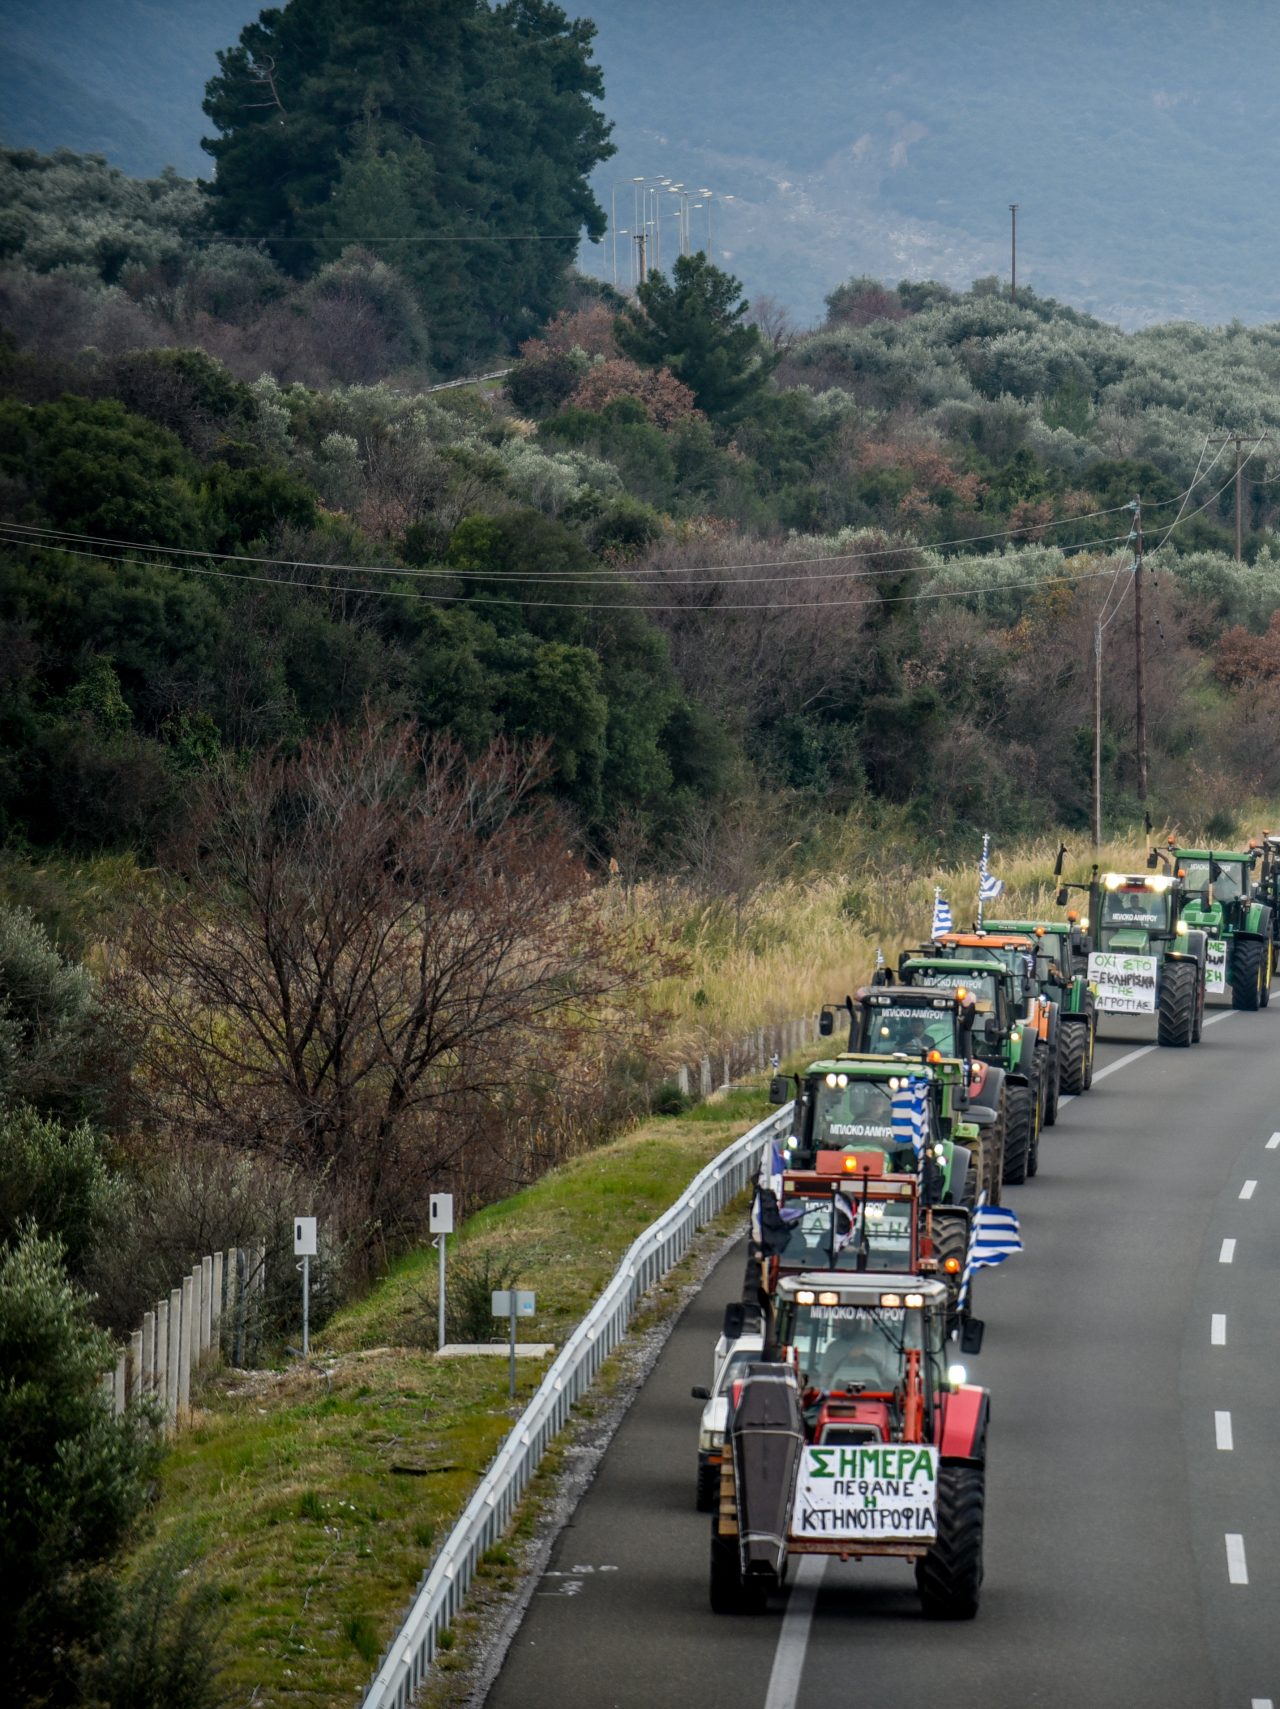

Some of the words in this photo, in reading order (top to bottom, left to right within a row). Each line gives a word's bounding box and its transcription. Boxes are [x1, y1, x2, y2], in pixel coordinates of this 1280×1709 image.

[1110, 985, 1134, 997] ΤΗΣ
[1096, 996, 1152, 1011] ΑΓΡΟΤΙΑΣ
[881, 1008, 911, 1018] ΜΠΛΟΚΟ
[830, 1123, 864, 1136] ΜΠΛΟΚΟ
[864, 1125, 894, 1138] ΑΛΜΥΡ
[810, 1306, 855, 1319] ΜΠΛΟΚΟ
[809, 1448, 934, 1481] ΣΗΜΕΡΑ
[833, 1480, 914, 1497] ΠΕΘΑΝΕ
[864, 1496, 877, 1508] Η
[801, 1507, 936, 1531] ΚΤΗΝΟΤΡΟΦΙΑ
